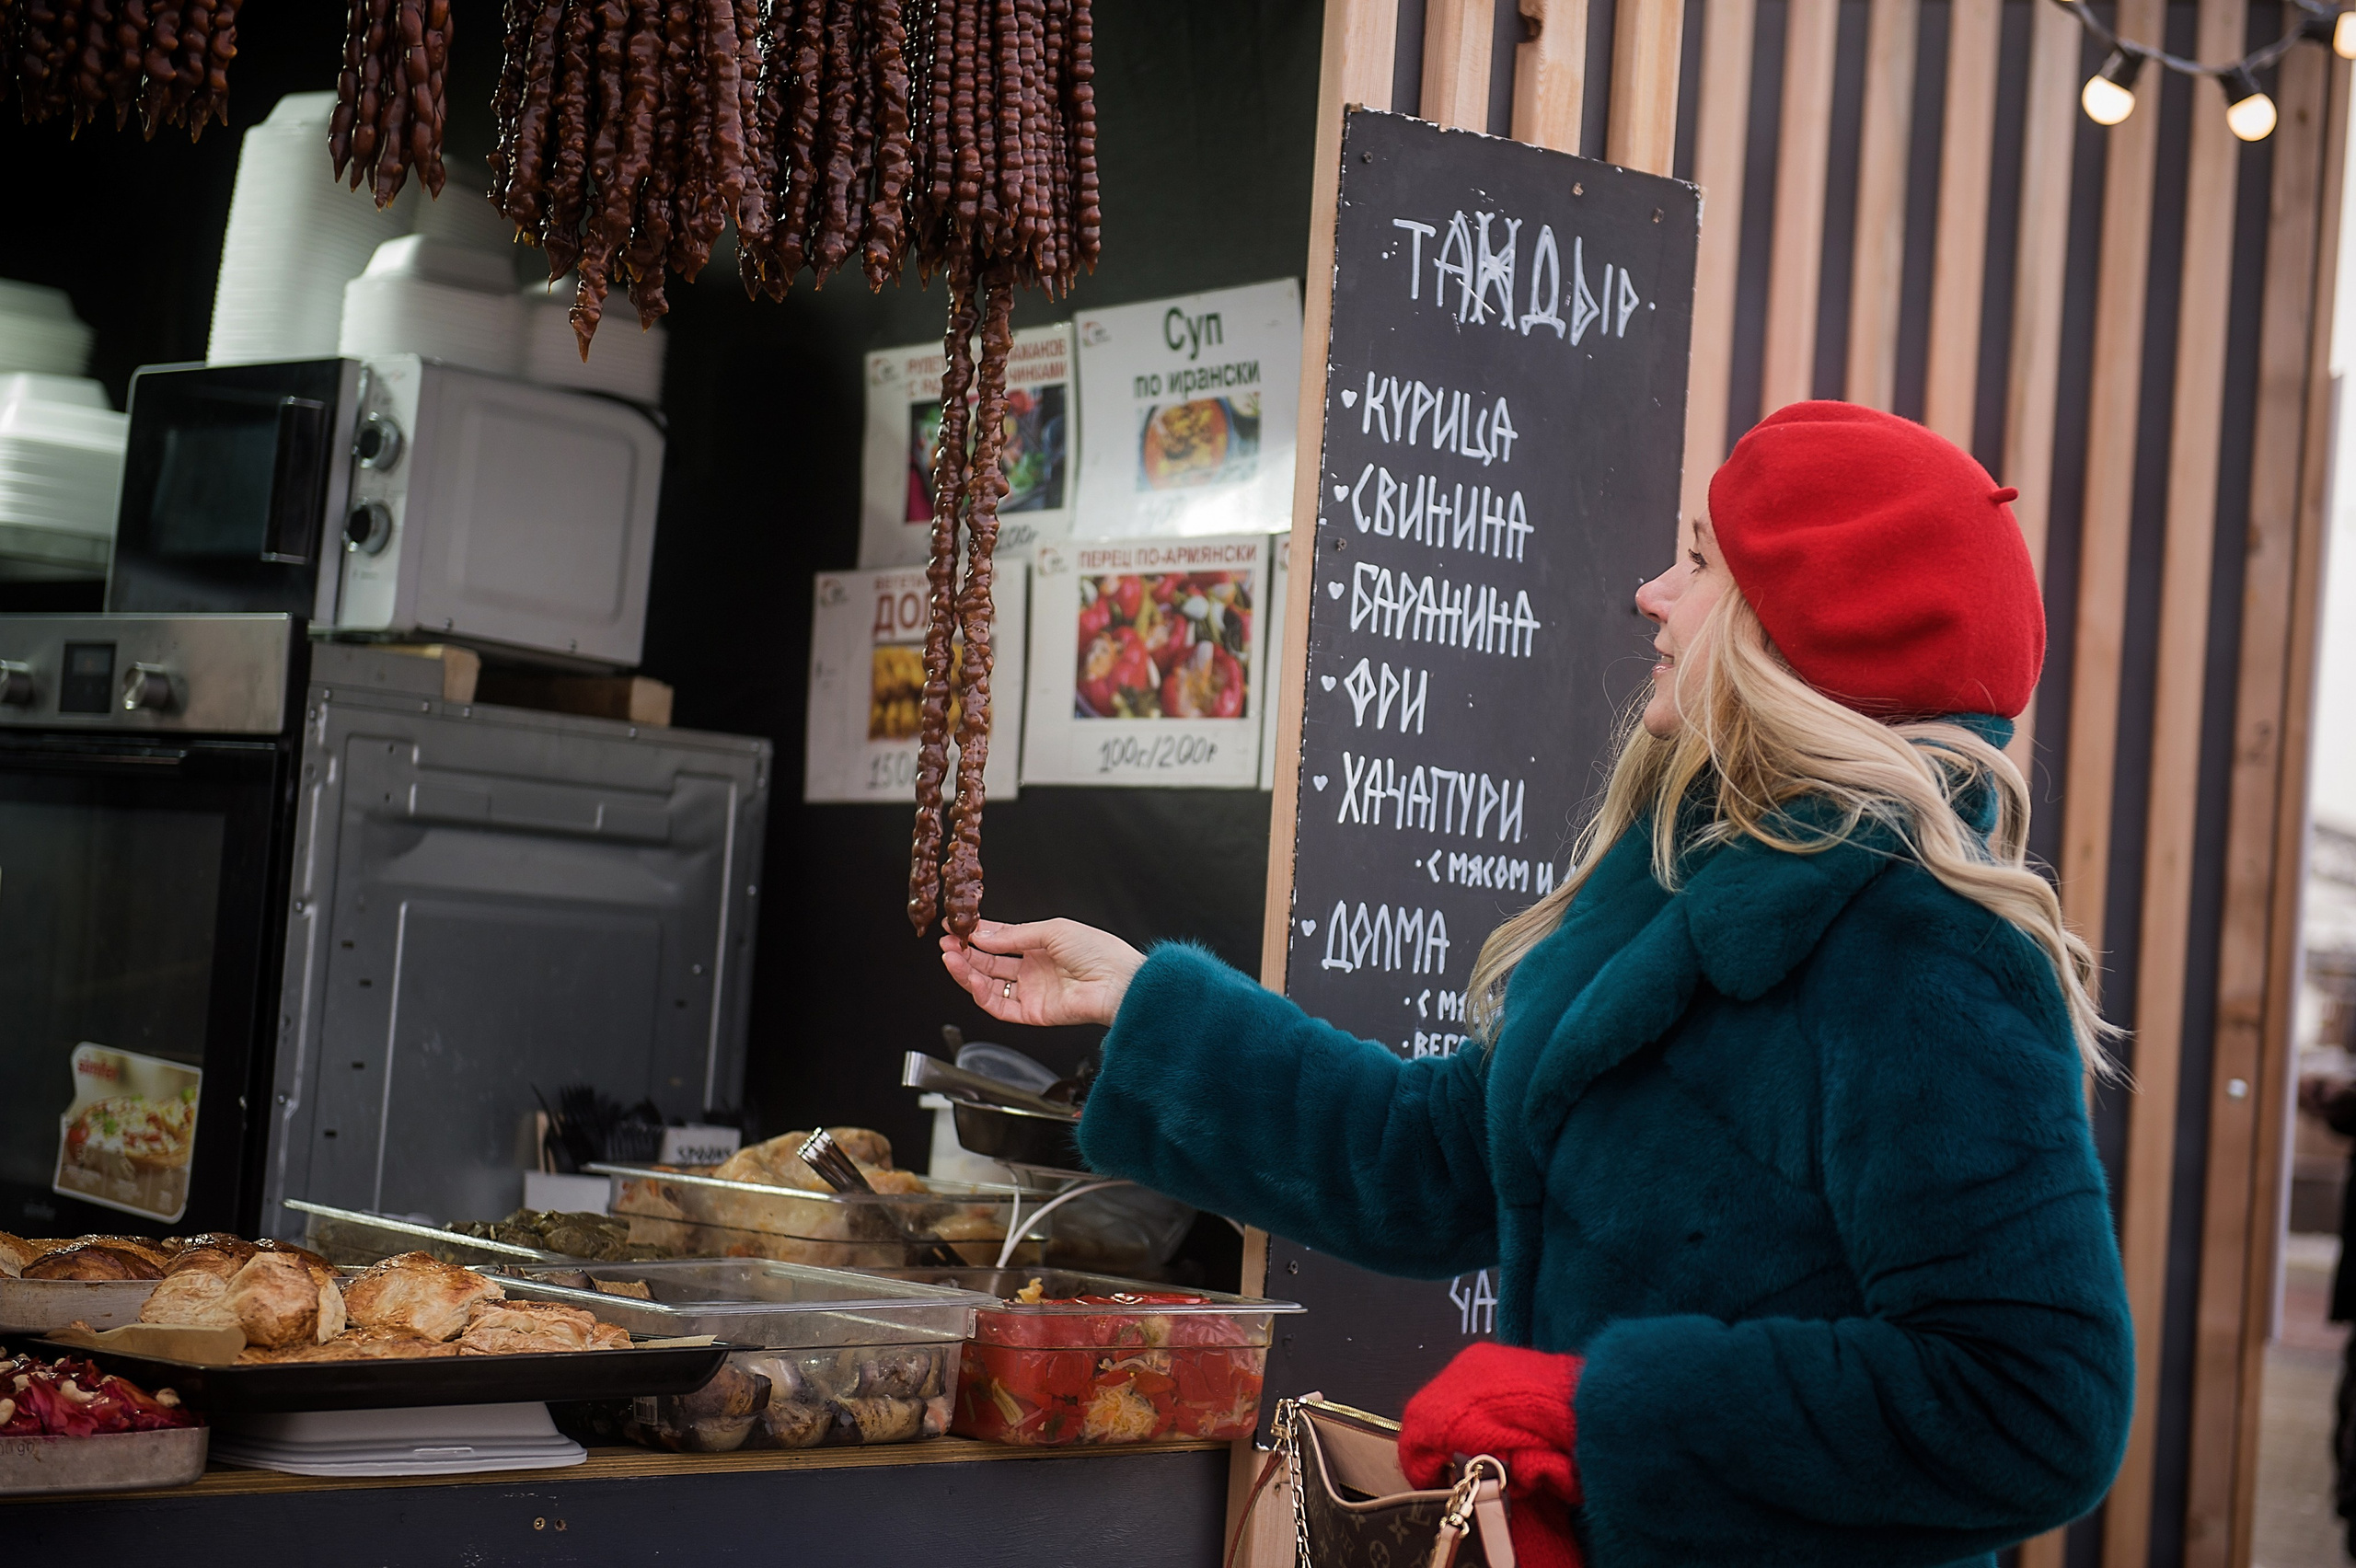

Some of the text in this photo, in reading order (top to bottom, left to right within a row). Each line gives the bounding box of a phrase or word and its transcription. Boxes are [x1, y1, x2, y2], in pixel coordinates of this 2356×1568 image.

[1163, 306, 1223, 361] Суп
[1134, 360, 1261, 399] по ирански
[1362, 371, 1519, 466] КУРИЦА
[1352, 463, 1535, 563] СВИНИНА
[1079, 549, 1132, 569] ПЕРЕЦ
[1136, 543, 1257, 566] ПО-АРМЯНСКИ
[1350, 561, 1542, 657] БАРАНИНА
[1343, 658, 1428, 734] ФРИ
[1337, 751, 1525, 843] ХАЧАПУРИ
[1427, 848, 1442, 883] С
[1448, 851, 1530, 893] МЯСОМ
[1536, 861, 1554, 895] И
[1322, 900, 1450, 974] ДОЛМА
[1449, 1268, 1498, 1334] ЧА
